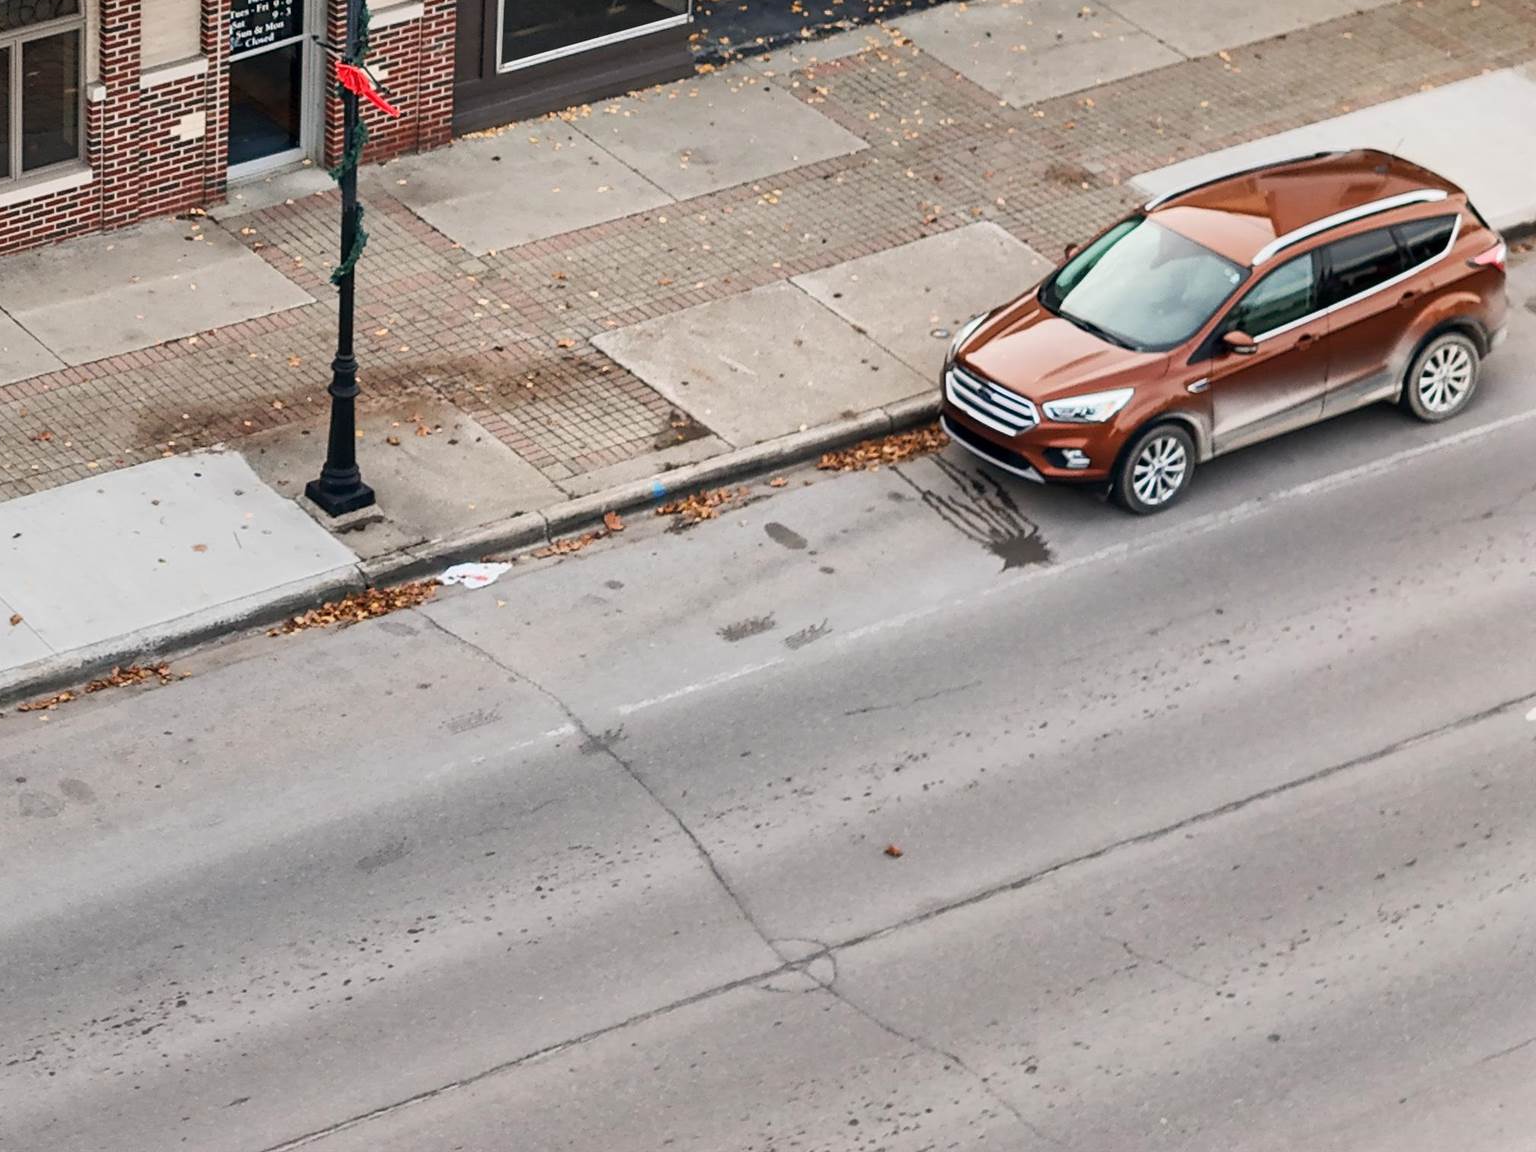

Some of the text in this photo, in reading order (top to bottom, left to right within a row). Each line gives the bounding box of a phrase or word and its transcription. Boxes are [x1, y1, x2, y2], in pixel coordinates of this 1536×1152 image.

[256, 2, 270, 13] Fri
[235, 29, 253, 41] Sun
[265, 21, 285, 32] Mon
[245, 33, 275, 48] Closed
